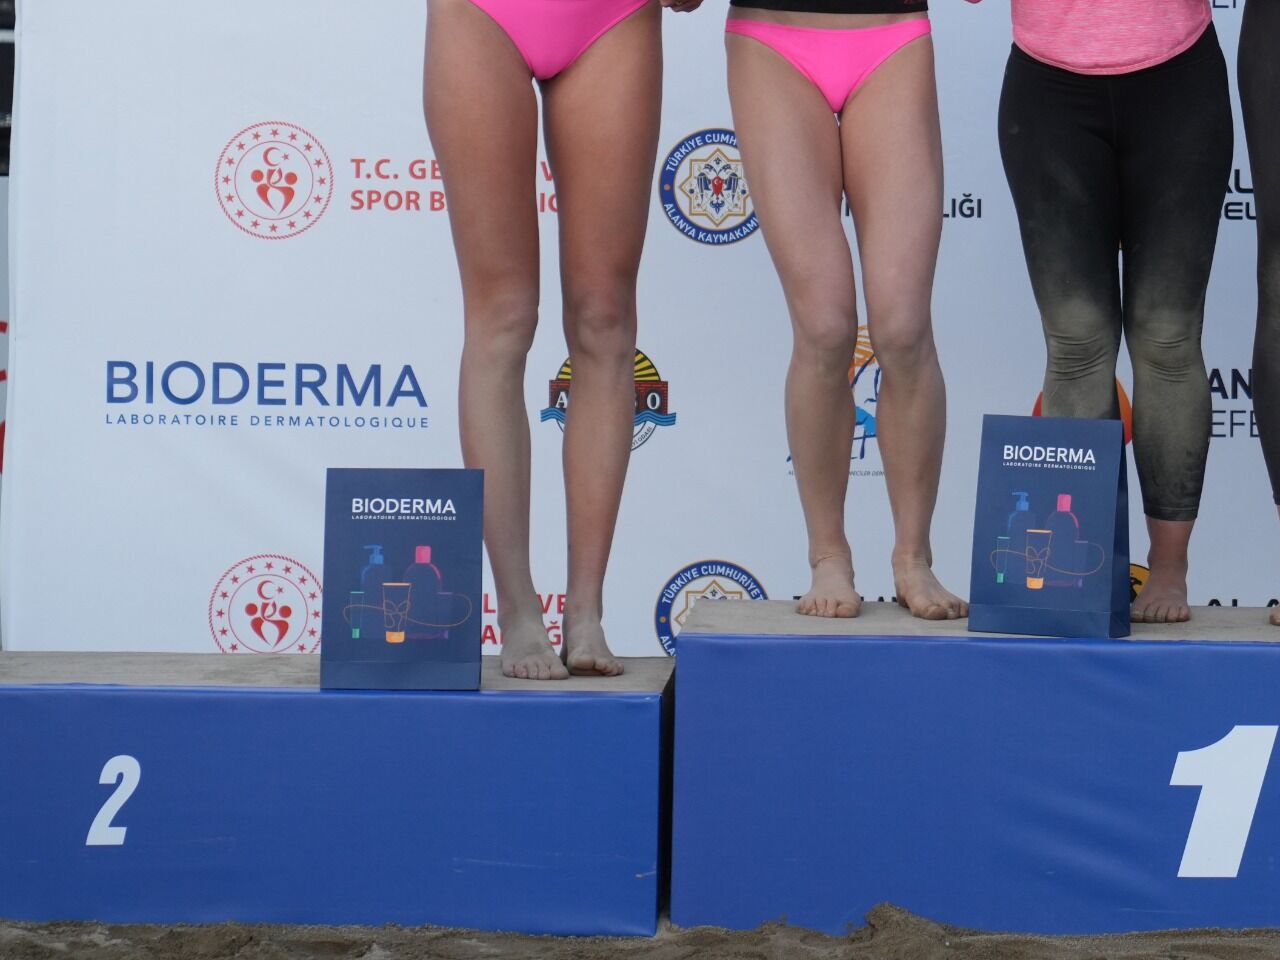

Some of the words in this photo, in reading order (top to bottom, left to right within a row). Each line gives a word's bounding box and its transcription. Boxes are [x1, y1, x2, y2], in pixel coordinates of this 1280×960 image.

[350, 158, 400, 180] T.C.
[666, 136, 703, 172] TÜRKİYE
[350, 189, 421, 211] SPOR
[664, 203, 696, 238] ALANYA
[697, 217, 759, 243] KAYMAKAM
[106, 360, 428, 408] BIODERMA
[106, 414, 239, 426] LABORATOIRE
[250, 415, 429, 429] DERMATOLOGIQUE
[1003, 445, 1096, 464] BIODERMA
[352, 498, 457, 514] BIODERMA
[661, 568, 700, 604] TÜRKİYE
[701, 565, 764, 600] CUMHURİYET
[86, 755, 141, 845] 2
[1169, 725, 1279, 878] 1
